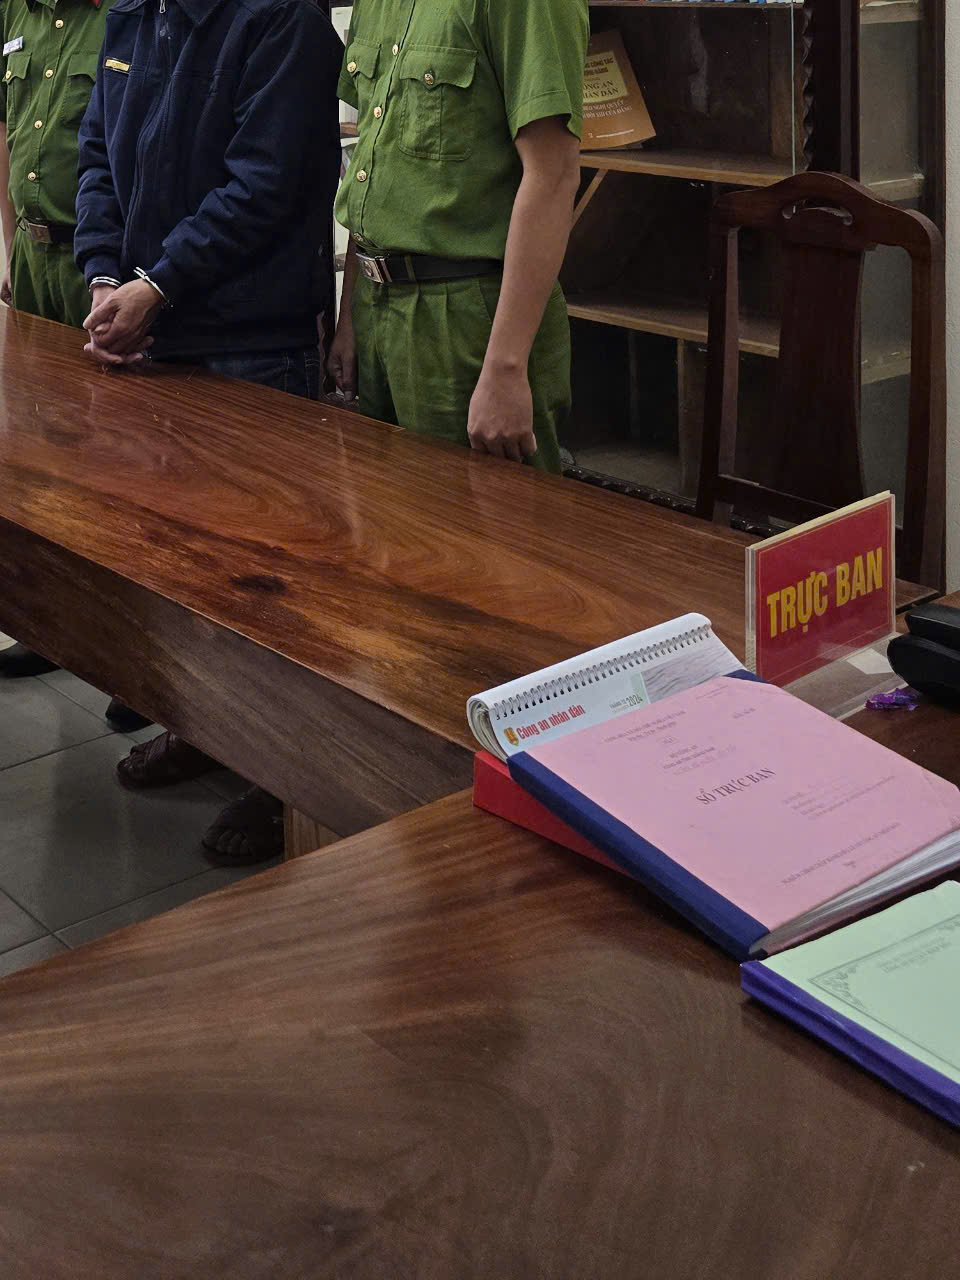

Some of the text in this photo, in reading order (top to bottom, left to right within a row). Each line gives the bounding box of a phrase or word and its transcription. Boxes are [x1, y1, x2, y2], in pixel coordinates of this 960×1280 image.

[767, 547, 883, 639] TRỰC BAN
[516, 704, 586, 740] Công an nhân dân
[695, 767, 776, 805] SỔ TRỰC BAN
